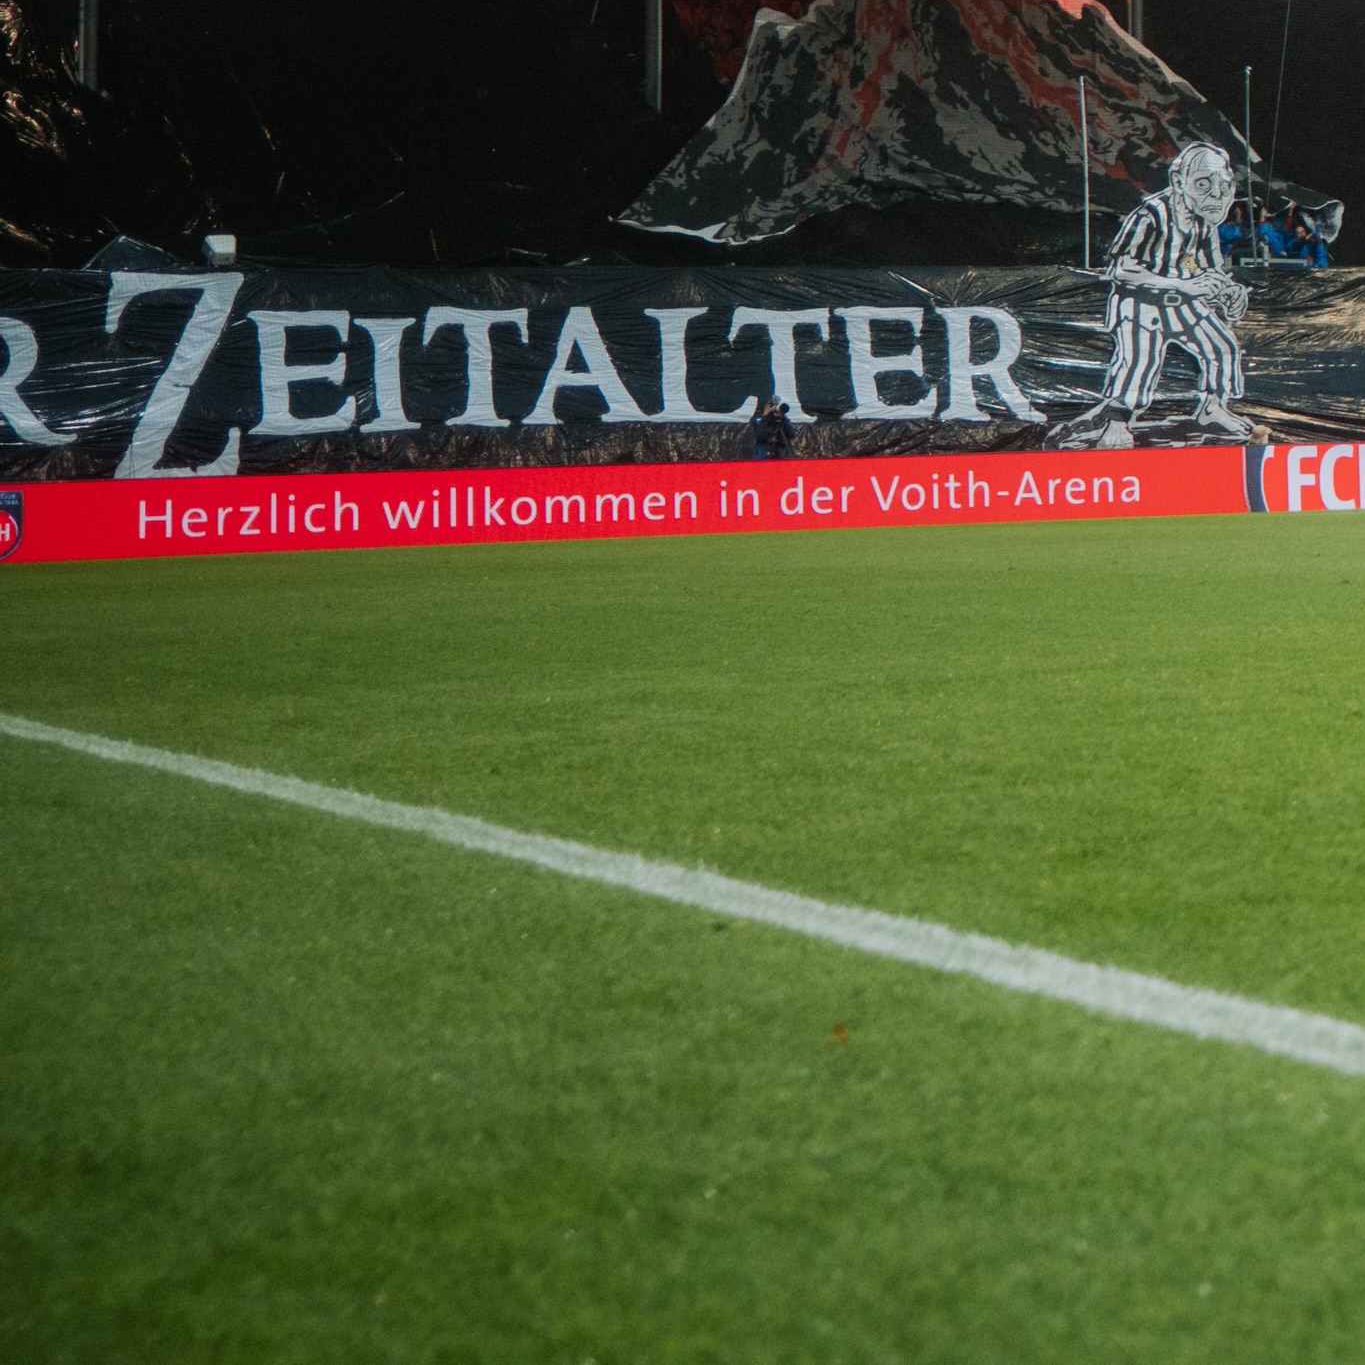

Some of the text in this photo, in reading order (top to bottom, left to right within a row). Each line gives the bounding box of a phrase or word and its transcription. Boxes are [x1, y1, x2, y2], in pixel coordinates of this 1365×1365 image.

[104, 271, 1047, 479] ZEITALTER
[138, 469, 1142, 540] Herzlich willkommen in der Voith-Arena
